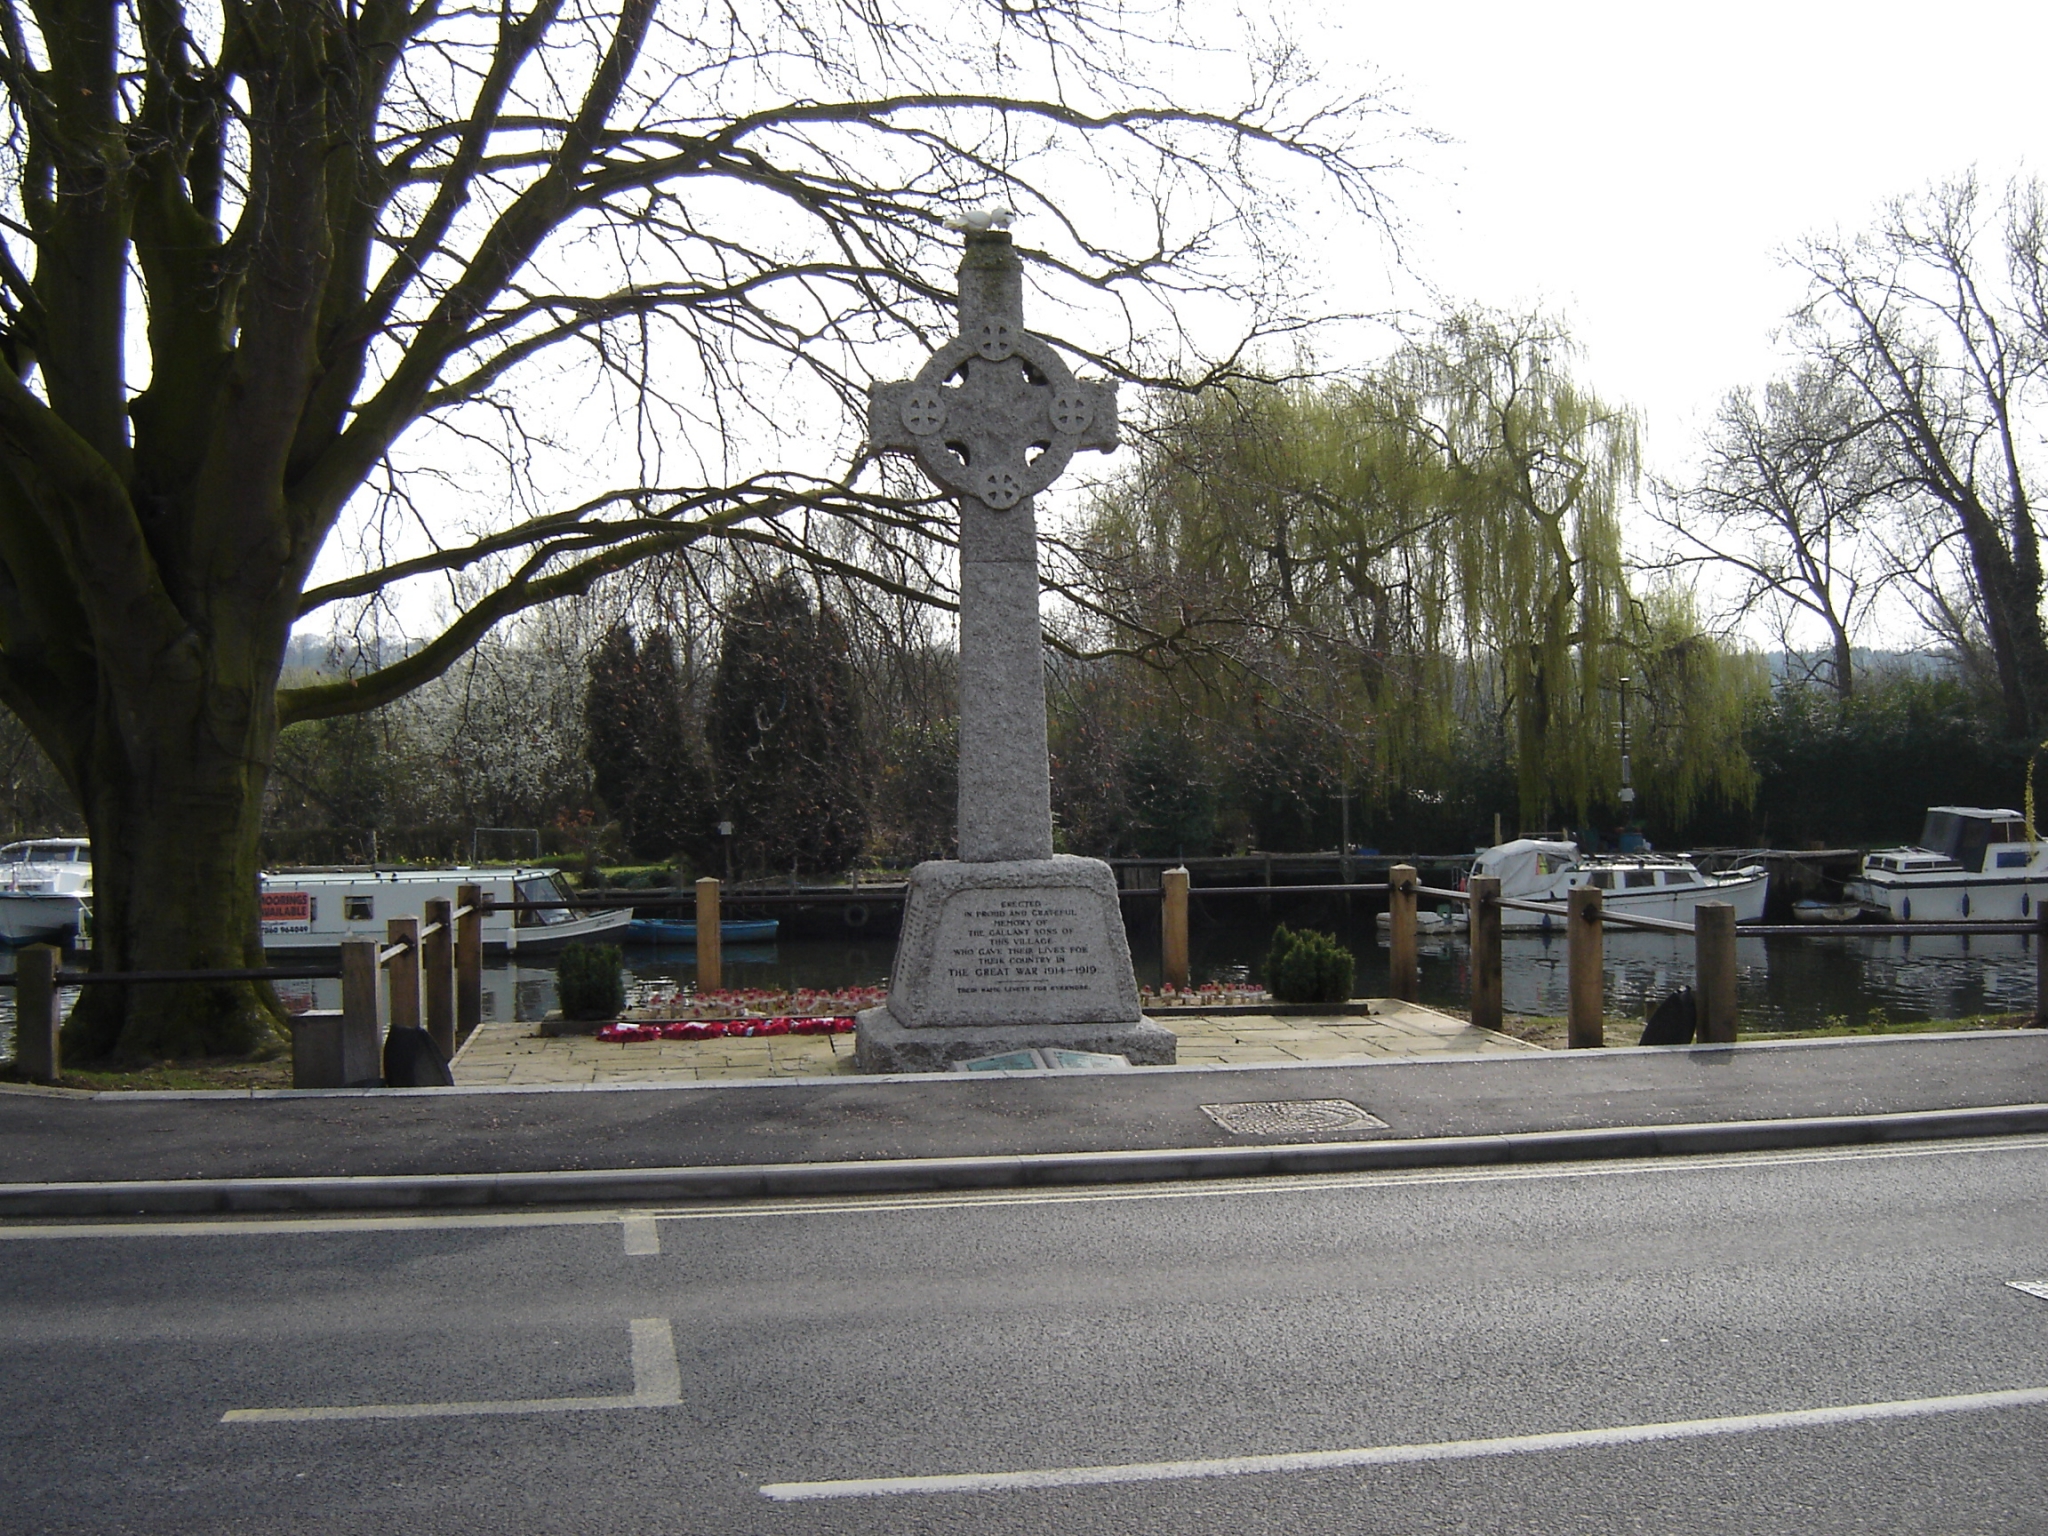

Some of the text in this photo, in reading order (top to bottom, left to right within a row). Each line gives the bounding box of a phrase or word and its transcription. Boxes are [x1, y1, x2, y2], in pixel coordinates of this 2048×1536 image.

[1001, 900, 1041, 908] ERECTED
[976, 910, 1005, 918] PROUD
[1034, 928, 1057, 936] SONS
[990, 937, 1052, 946] THIS VILLAGE
[1008, 947, 1033, 955] THEIR
[1038, 946, 1065, 954] LIVES
[1070, 946, 1088, 954] FOR
[979, 955, 1065, 965] THEIR COUNTRY IN
[948, 968, 968, 977] THE
[975, 968, 1009, 976] GREAT
[1016, 967, 1038, 976] WAR
